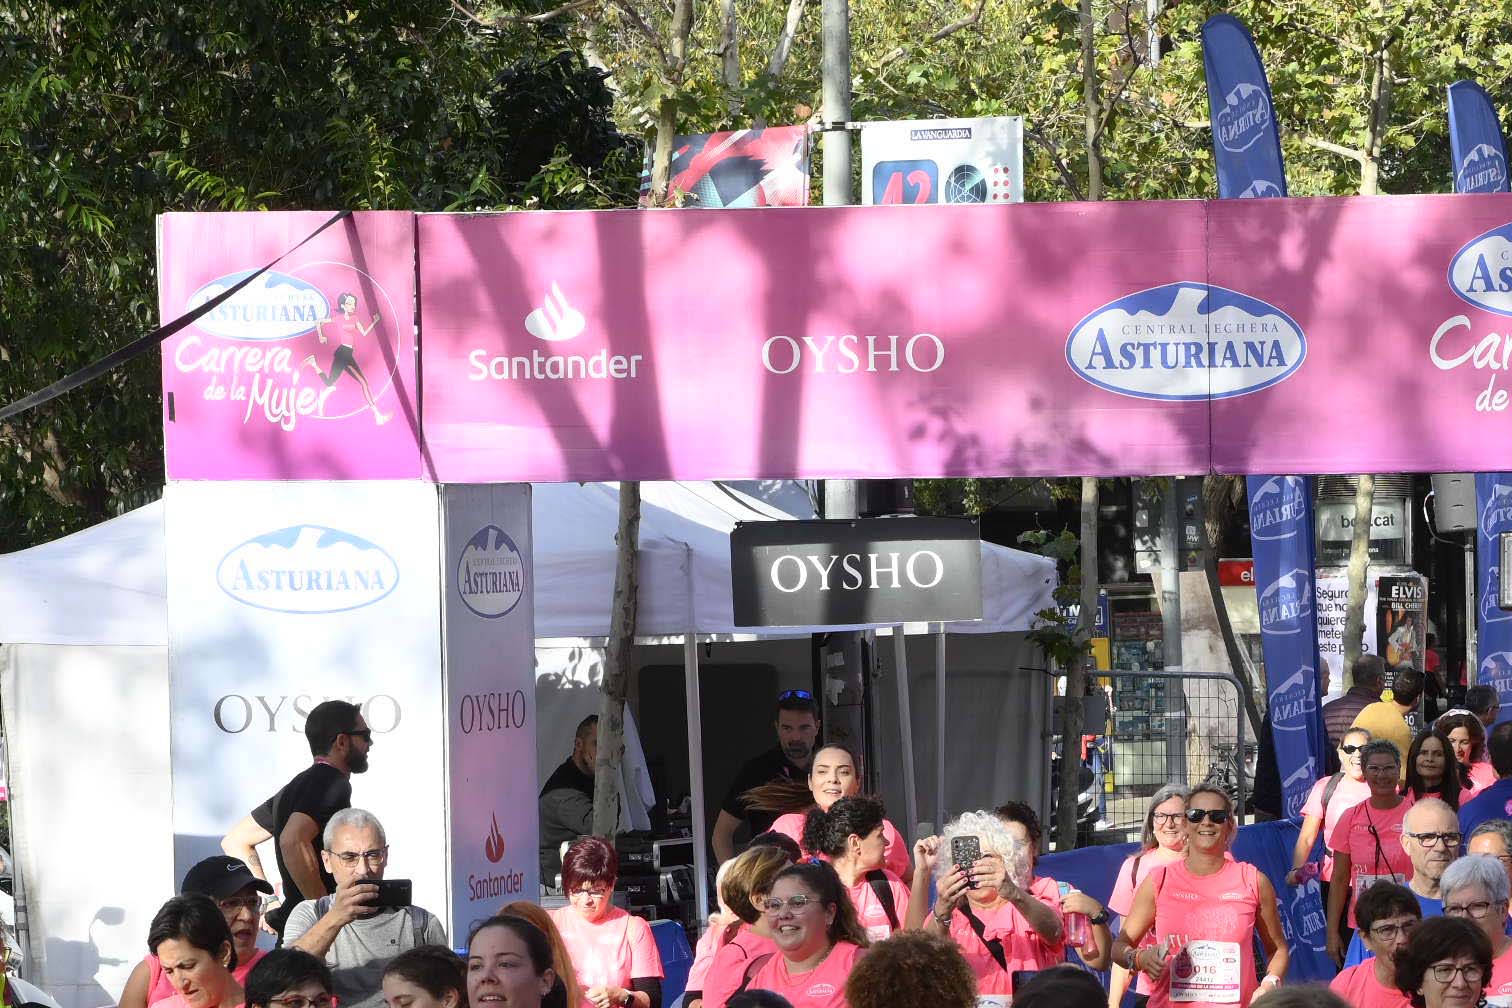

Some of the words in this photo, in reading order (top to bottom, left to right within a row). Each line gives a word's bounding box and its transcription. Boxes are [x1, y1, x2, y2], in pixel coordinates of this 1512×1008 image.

[1121, 323, 1196, 335] CENTRAL
[1202, 321, 1279, 335] LECHERA
[175, 335, 293, 374] Carrera
[468, 348, 642, 381] Santander
[761, 333, 945, 374] OYSHO
[1085, 326, 1288, 370] ASTURIANA
[203, 374, 227, 400] de
[229, 373, 247, 401] la
[243, 371, 337, 432] Mujer
[1475, 373, 1509, 412] de
[231, 559, 386, 591] ASTURIANA
[462, 565, 521, 595] ASTURIANA
[770, 550, 945, 593] OYSHO
[1317, 603, 1333, 614] que
[1391, 586, 1422, 598] ELVIS
[213, 693, 401, 734] OYSO
[459, 689, 527, 734] OYSHO
[468, 869, 525, 903] Santander
